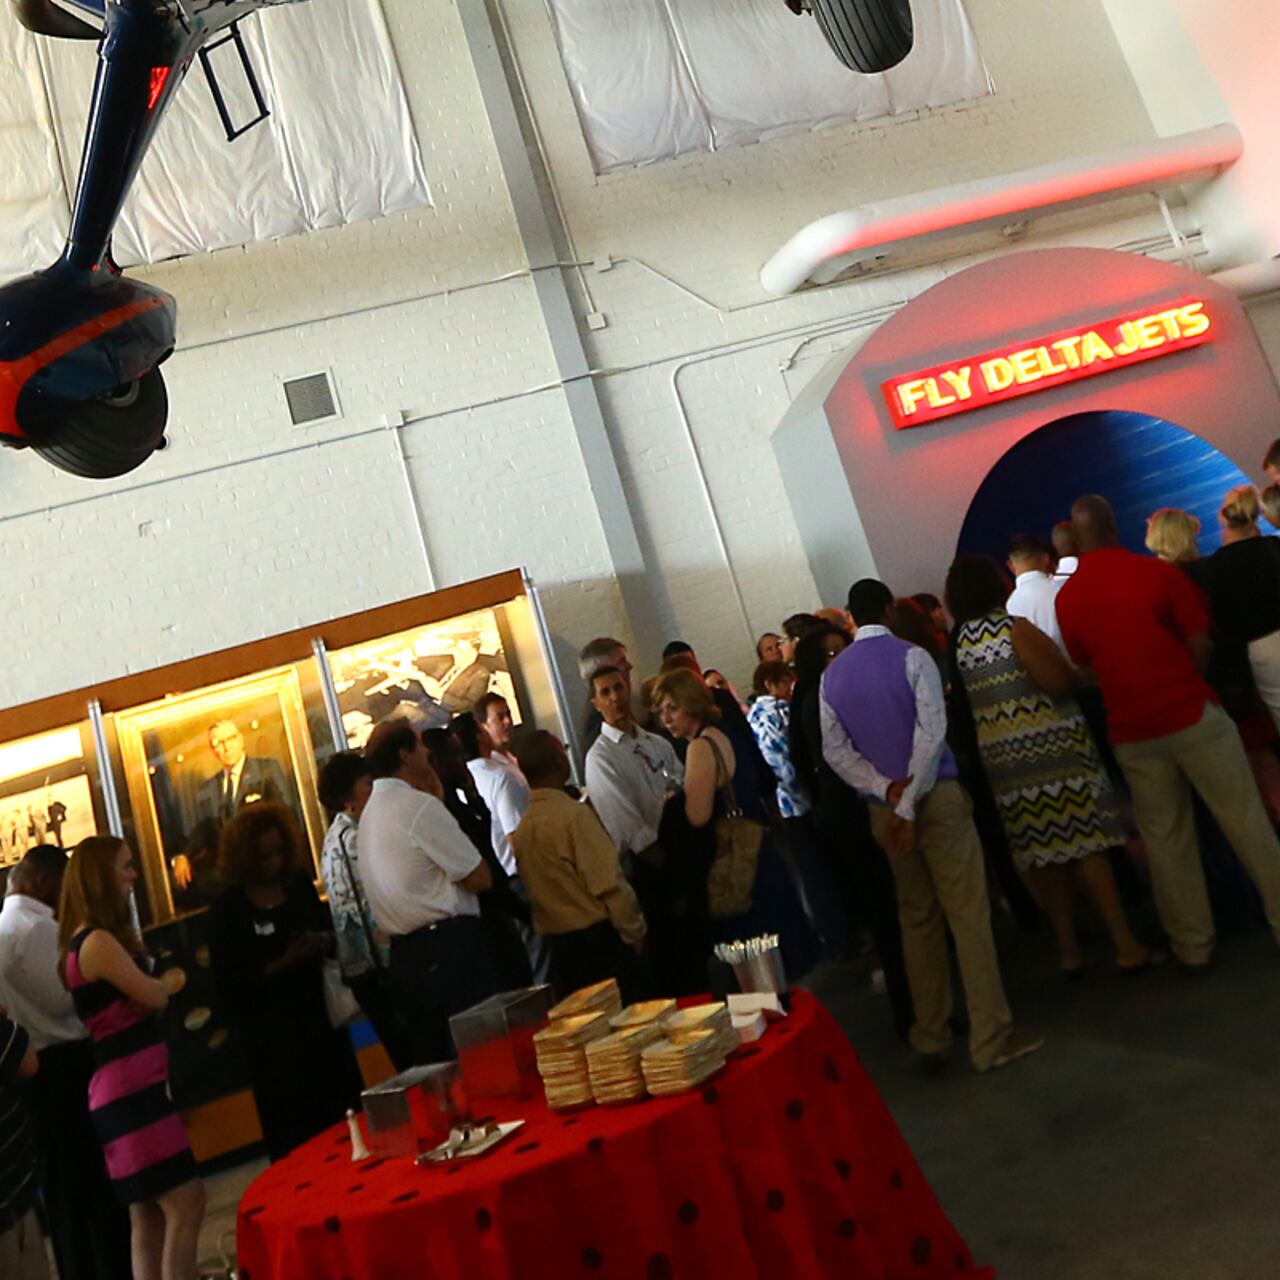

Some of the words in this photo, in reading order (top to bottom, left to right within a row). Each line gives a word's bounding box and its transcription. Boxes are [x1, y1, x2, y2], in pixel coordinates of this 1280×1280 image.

[897, 365, 972, 416] FLY
[981, 330, 1114, 393] DELTA
[1114, 301, 1211, 355] JETS
